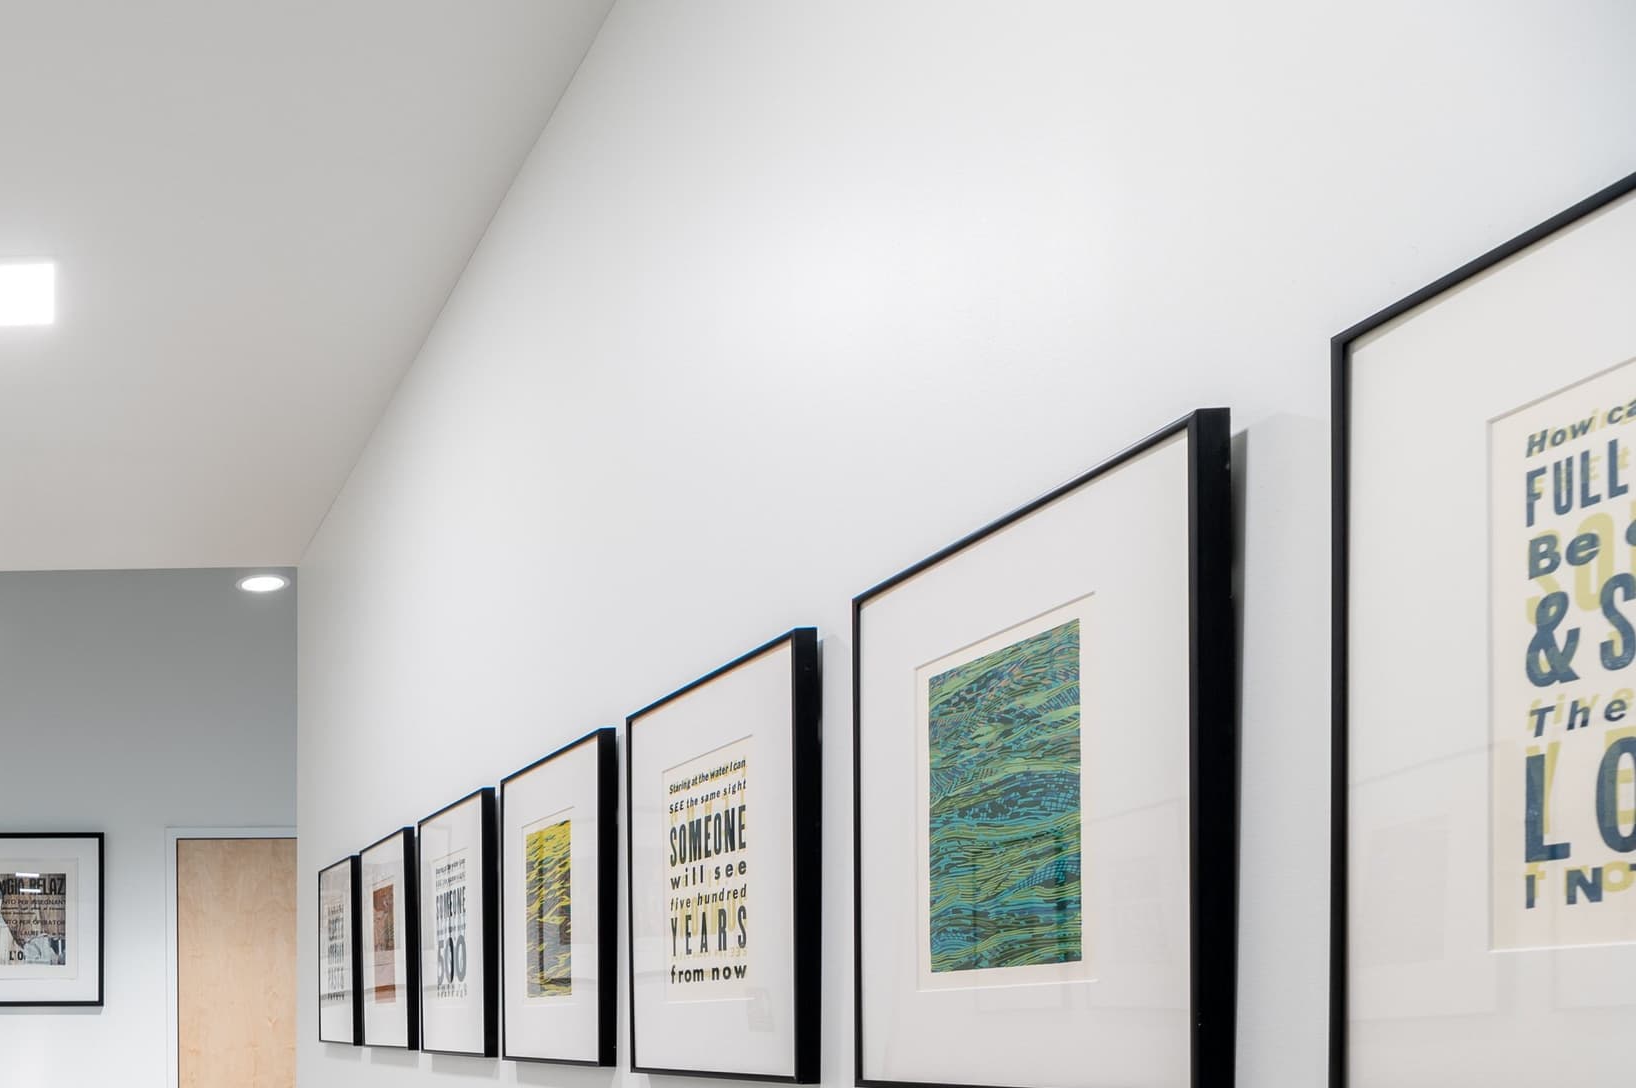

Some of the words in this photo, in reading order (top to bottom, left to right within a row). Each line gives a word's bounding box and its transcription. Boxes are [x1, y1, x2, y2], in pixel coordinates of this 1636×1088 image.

[1525, 415, 1595, 458] How
[1525, 438, 1629, 528] FULL
[1527, 532, 1600, 580] Be
[1525, 591, 1581, 687] &
[1599, 572, 1636, 671] S
[1529, 698, 1628, 738] The
[669, 776, 692, 795] Staring
[691, 774, 699, 787] at
[699, 770, 710, 783] the
[669, 799, 684, 815] SEE
[686, 794, 699, 809] the
[700, 789, 721, 805] same
[723, 779, 747, 797] sight
[1524, 736, 1636, 863] LO
[669, 804, 747, 868] SOMEONE
[670, 864, 704, 891] will
[714, 860, 747, 881] see
[670, 897, 691, 912] five
[697, 883, 747, 906] hundred
[670, 904, 747, 958] YEARS
[437, 935, 467, 986] 500
[670, 964, 705, 985] from
[711, 963, 747, 982] now
